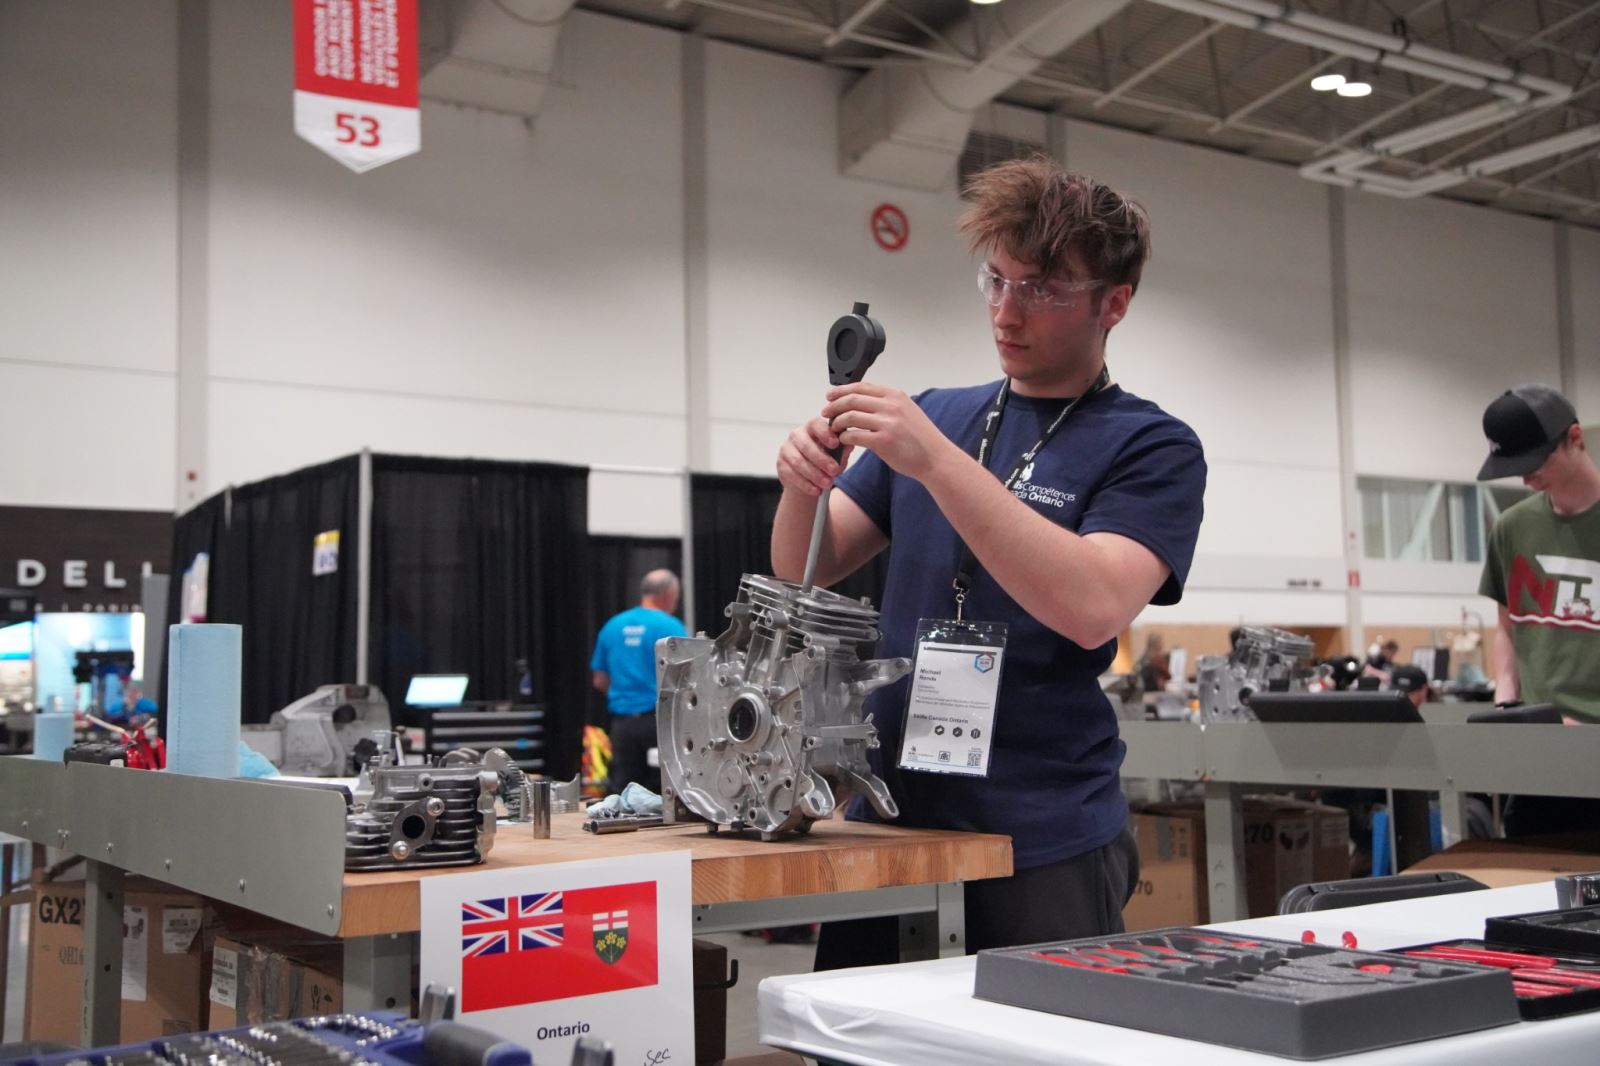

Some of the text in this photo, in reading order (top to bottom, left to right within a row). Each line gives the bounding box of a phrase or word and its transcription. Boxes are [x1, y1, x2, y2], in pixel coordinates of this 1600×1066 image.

[335, 112, 381, 147] 53
[1022, 482, 1076, 501] Compétences
[1028, 491, 1064, 508] Ontario
[1245, 823, 1274, 843] 70
[39, 895, 86, 925] GX2
[536, 1021, 591, 1041] Ontario
